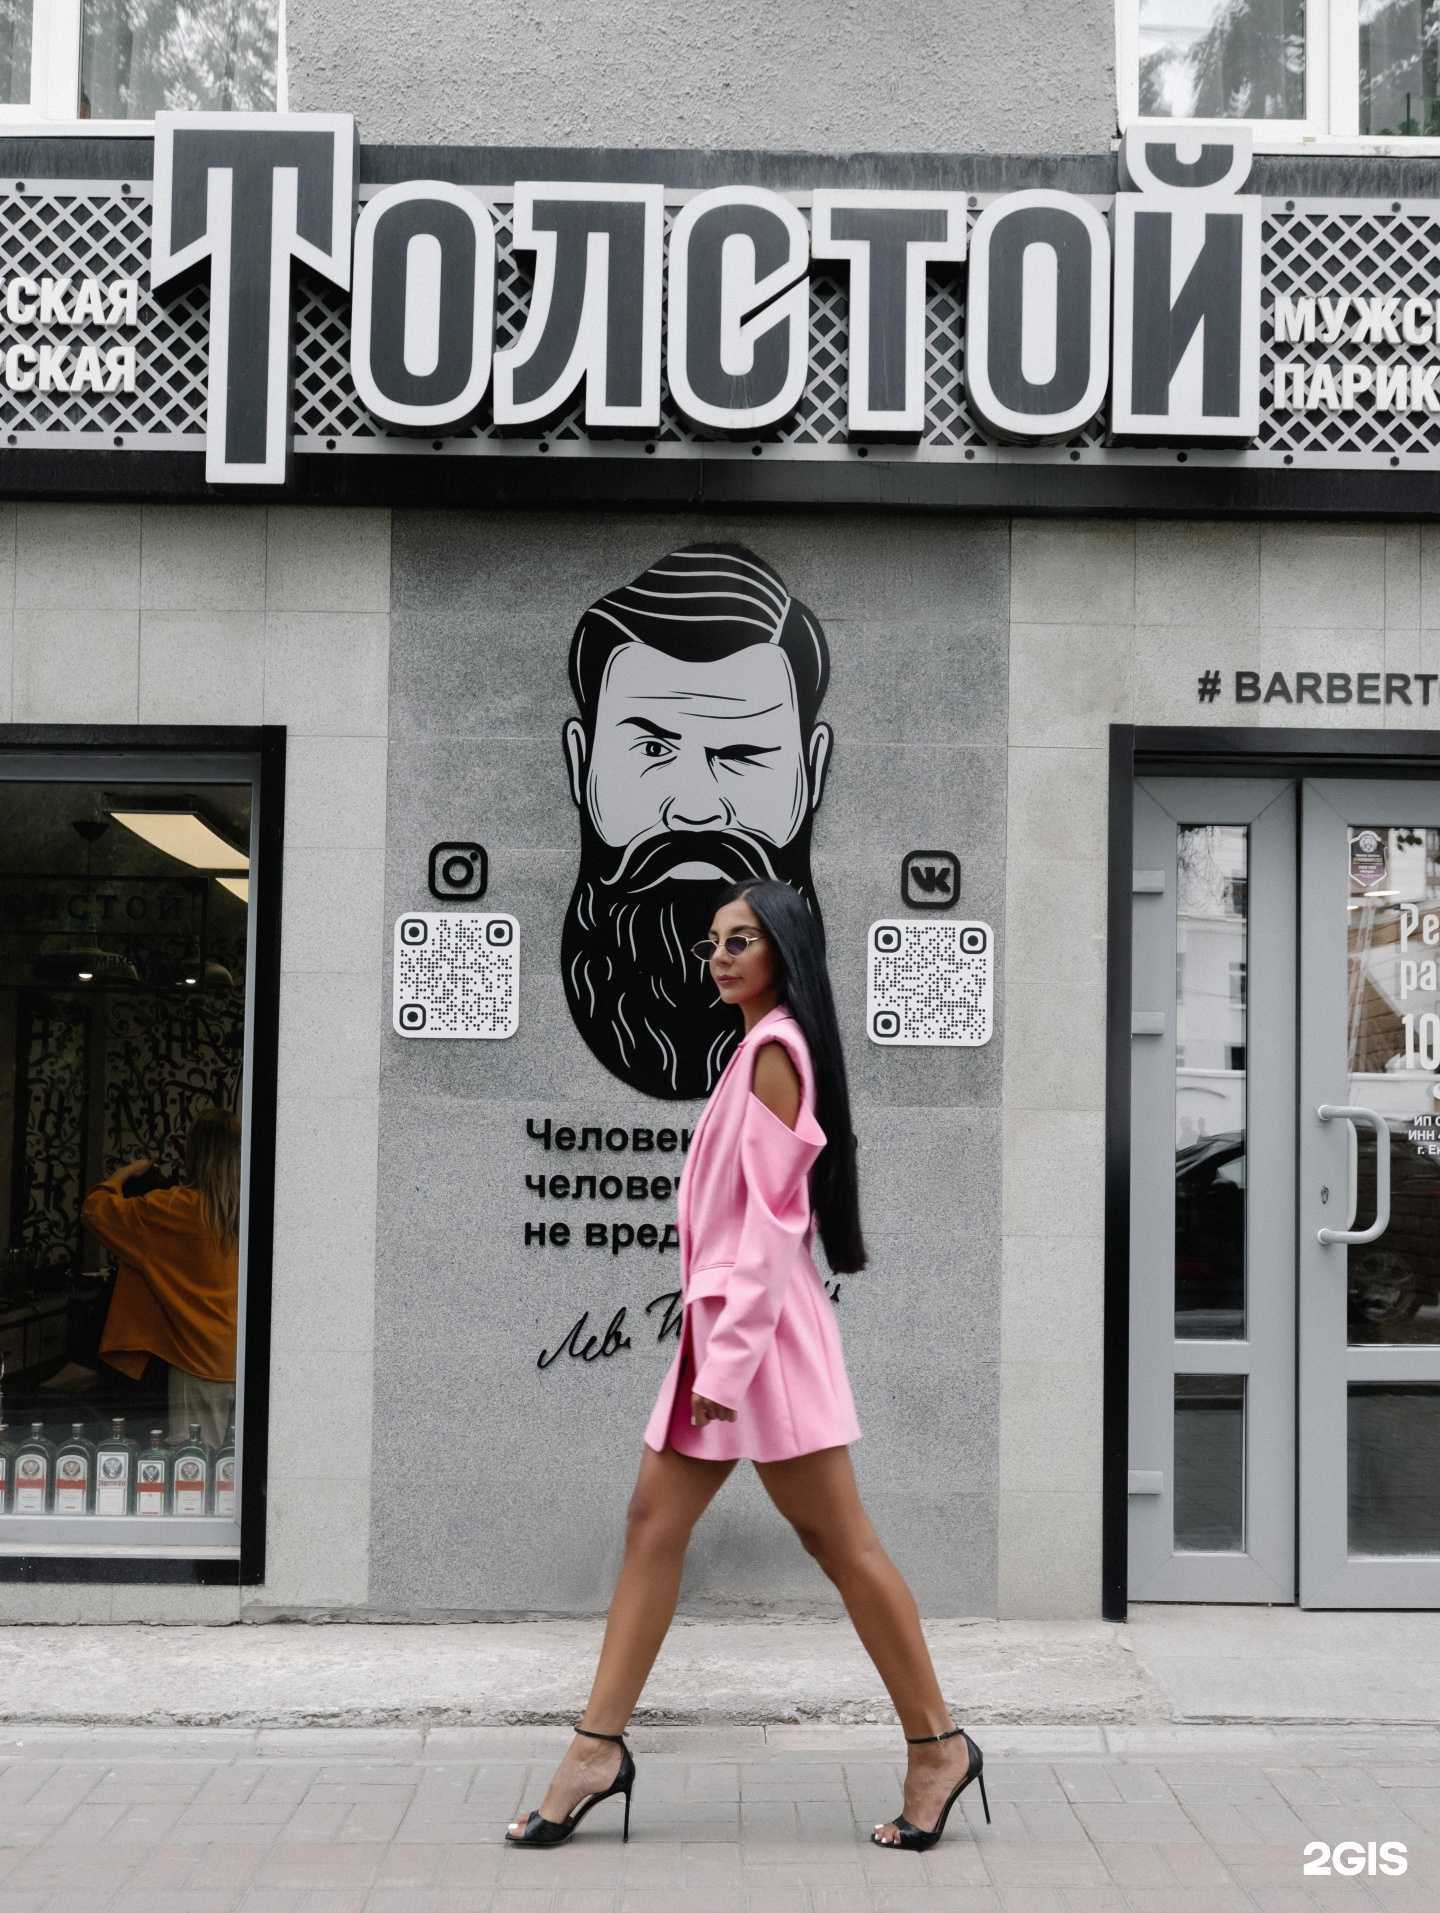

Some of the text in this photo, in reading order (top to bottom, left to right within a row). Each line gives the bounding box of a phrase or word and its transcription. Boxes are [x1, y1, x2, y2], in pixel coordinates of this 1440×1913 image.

[0, 277, 139, 326] СКАЯ
[1274, 296, 1440, 346] МУЖС
[0, 343, 137, 393] СКАЯ
[1273, 363, 1440, 412] ПАРИК
[1235, 671, 1440, 706] BARBERT
[1408, 1129, 1435, 1141] ИНН
[1414, 1115, 1432, 1127] ИП
[524, 1221, 571, 1247] не
